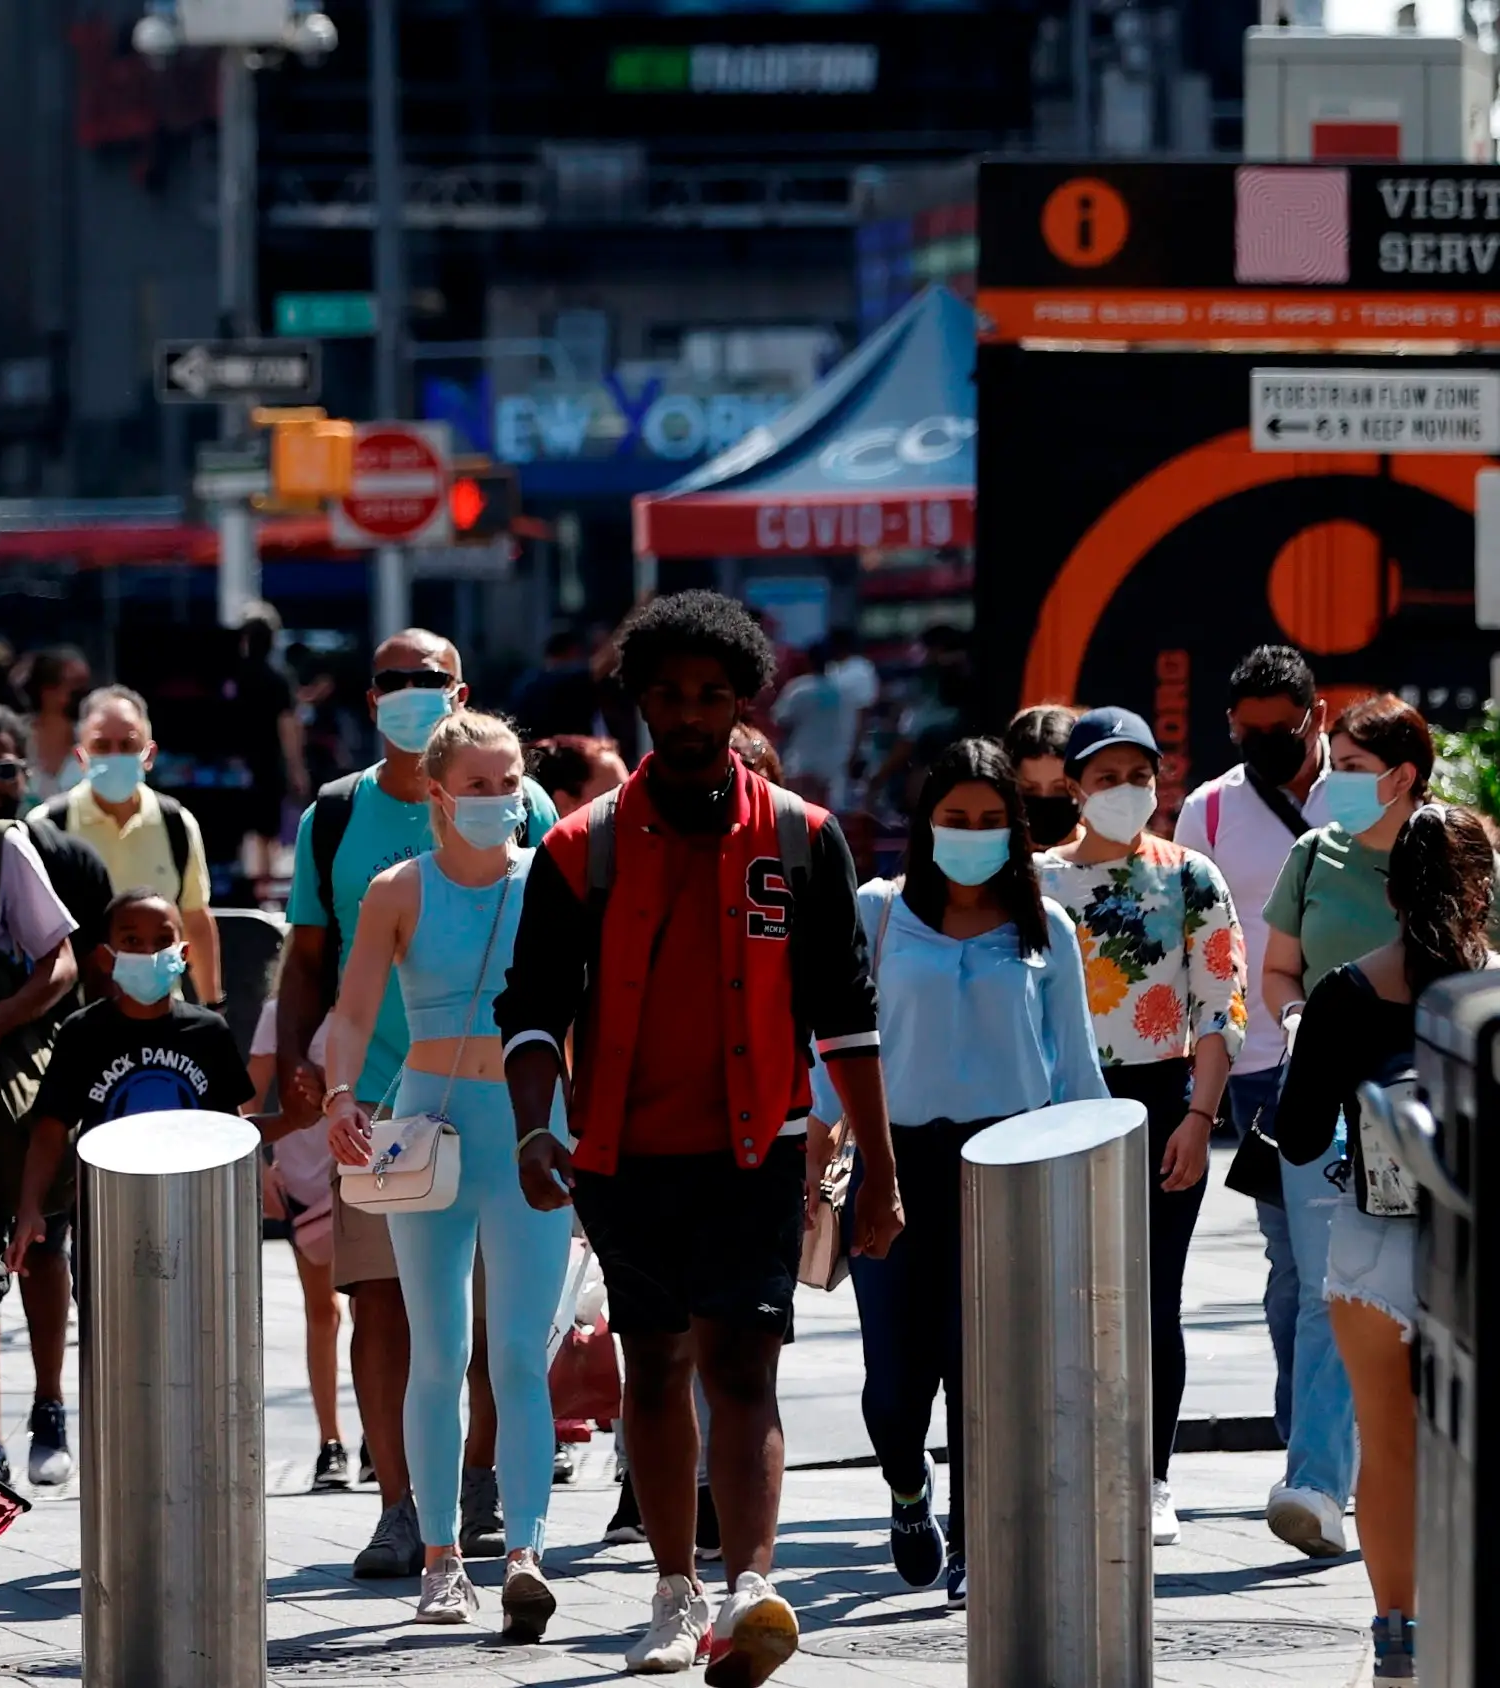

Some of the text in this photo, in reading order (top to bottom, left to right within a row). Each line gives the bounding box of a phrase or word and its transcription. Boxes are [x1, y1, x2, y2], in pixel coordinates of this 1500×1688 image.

[1261, 385, 1483, 411] PEDESTRIAN FLOW ZONE
[1360, 417, 1485, 443] KEEP MOVING
[756, 502, 953, 549] COVID-19
[744, 855, 796, 941] S
[88, 1046, 209, 1103] BLACK PANTHER
